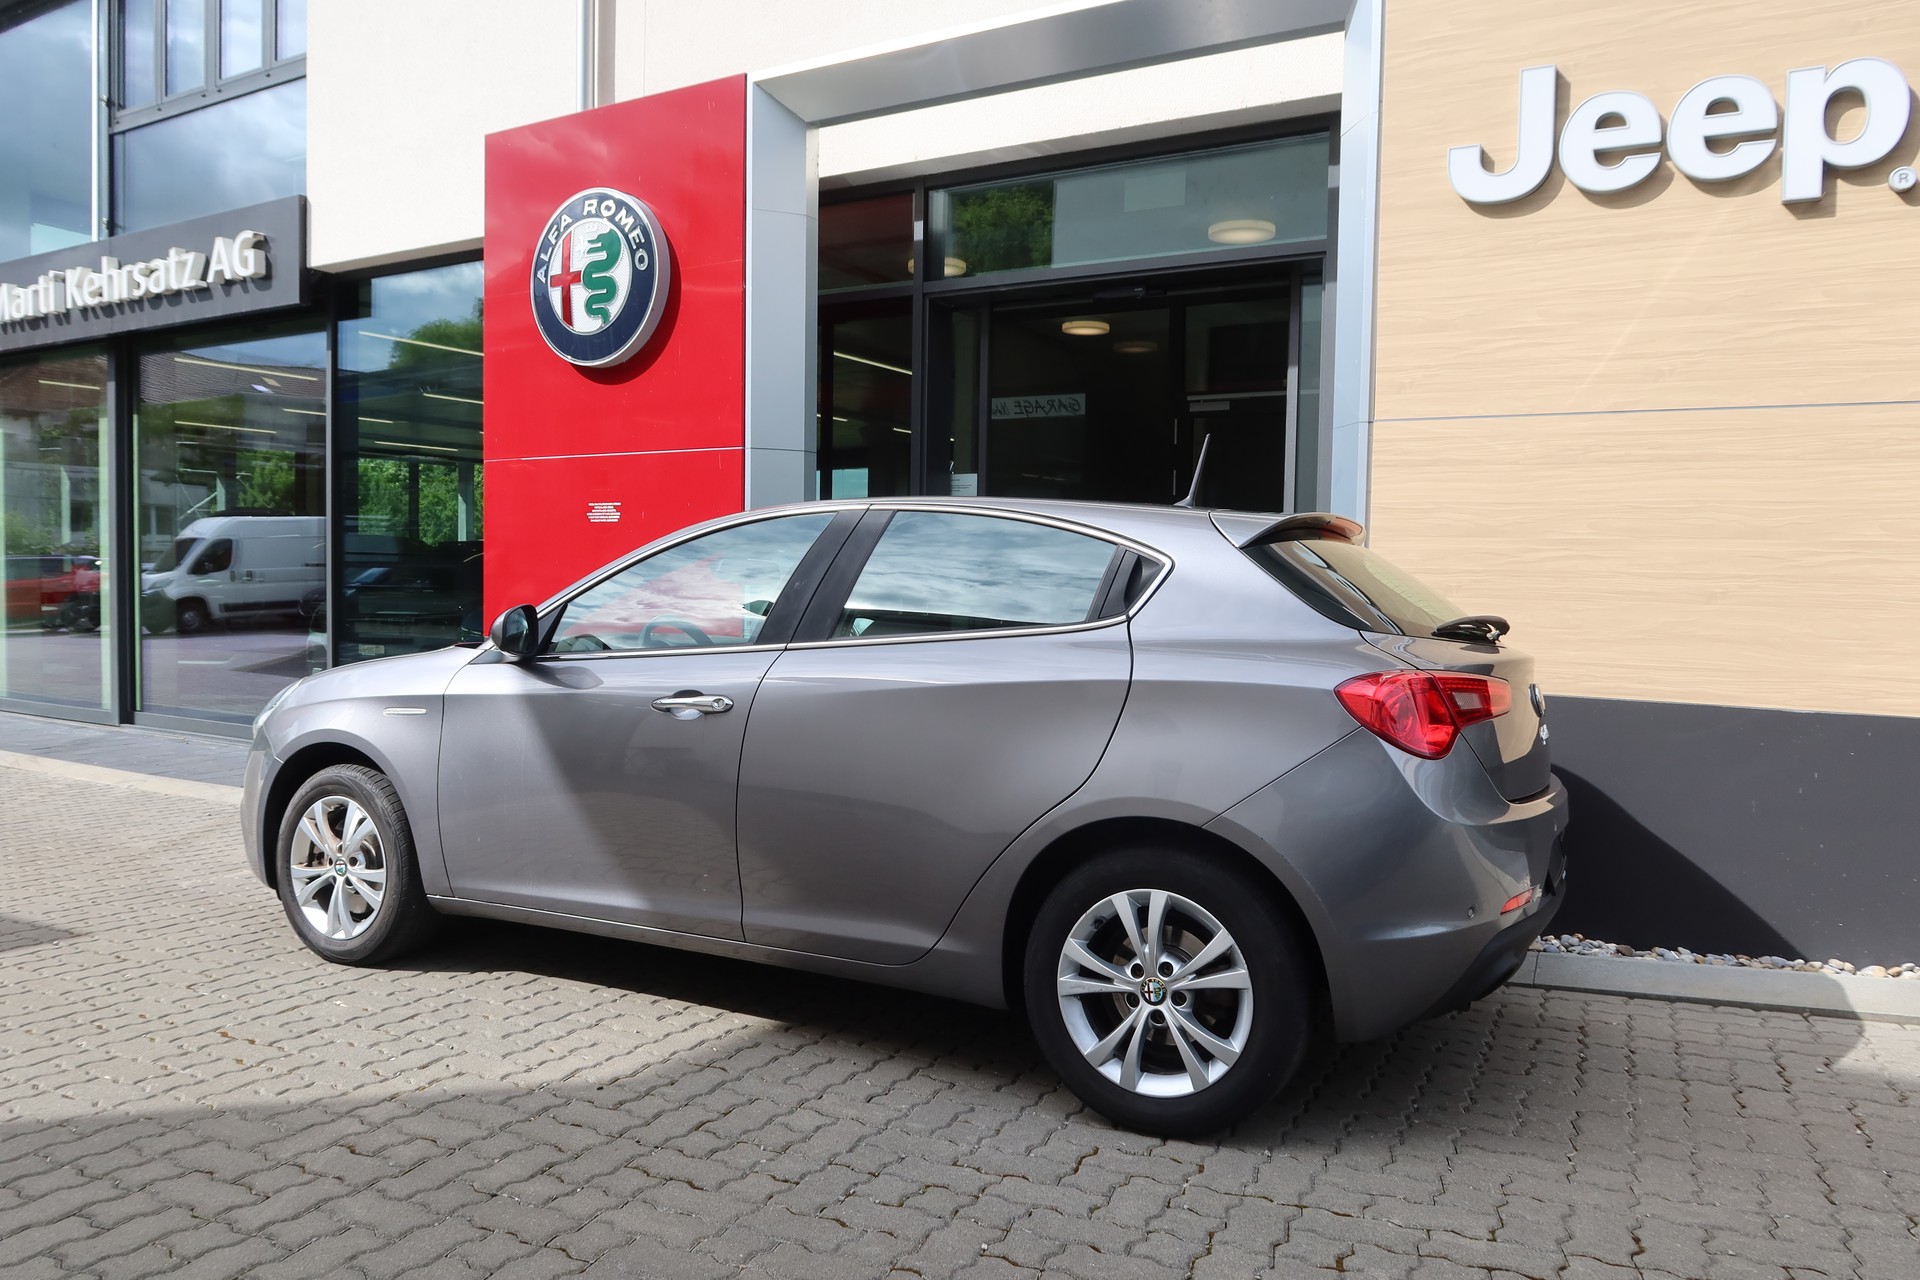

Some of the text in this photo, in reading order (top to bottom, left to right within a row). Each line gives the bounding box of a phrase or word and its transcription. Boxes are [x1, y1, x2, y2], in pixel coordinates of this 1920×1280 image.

[1448, 57, 1911, 203] Jeep
[65, 247, 207, 311] Kehrsatz
[207, 230, 266, 285] AG
[536, 198, 649, 284] ALFA ROMEO
